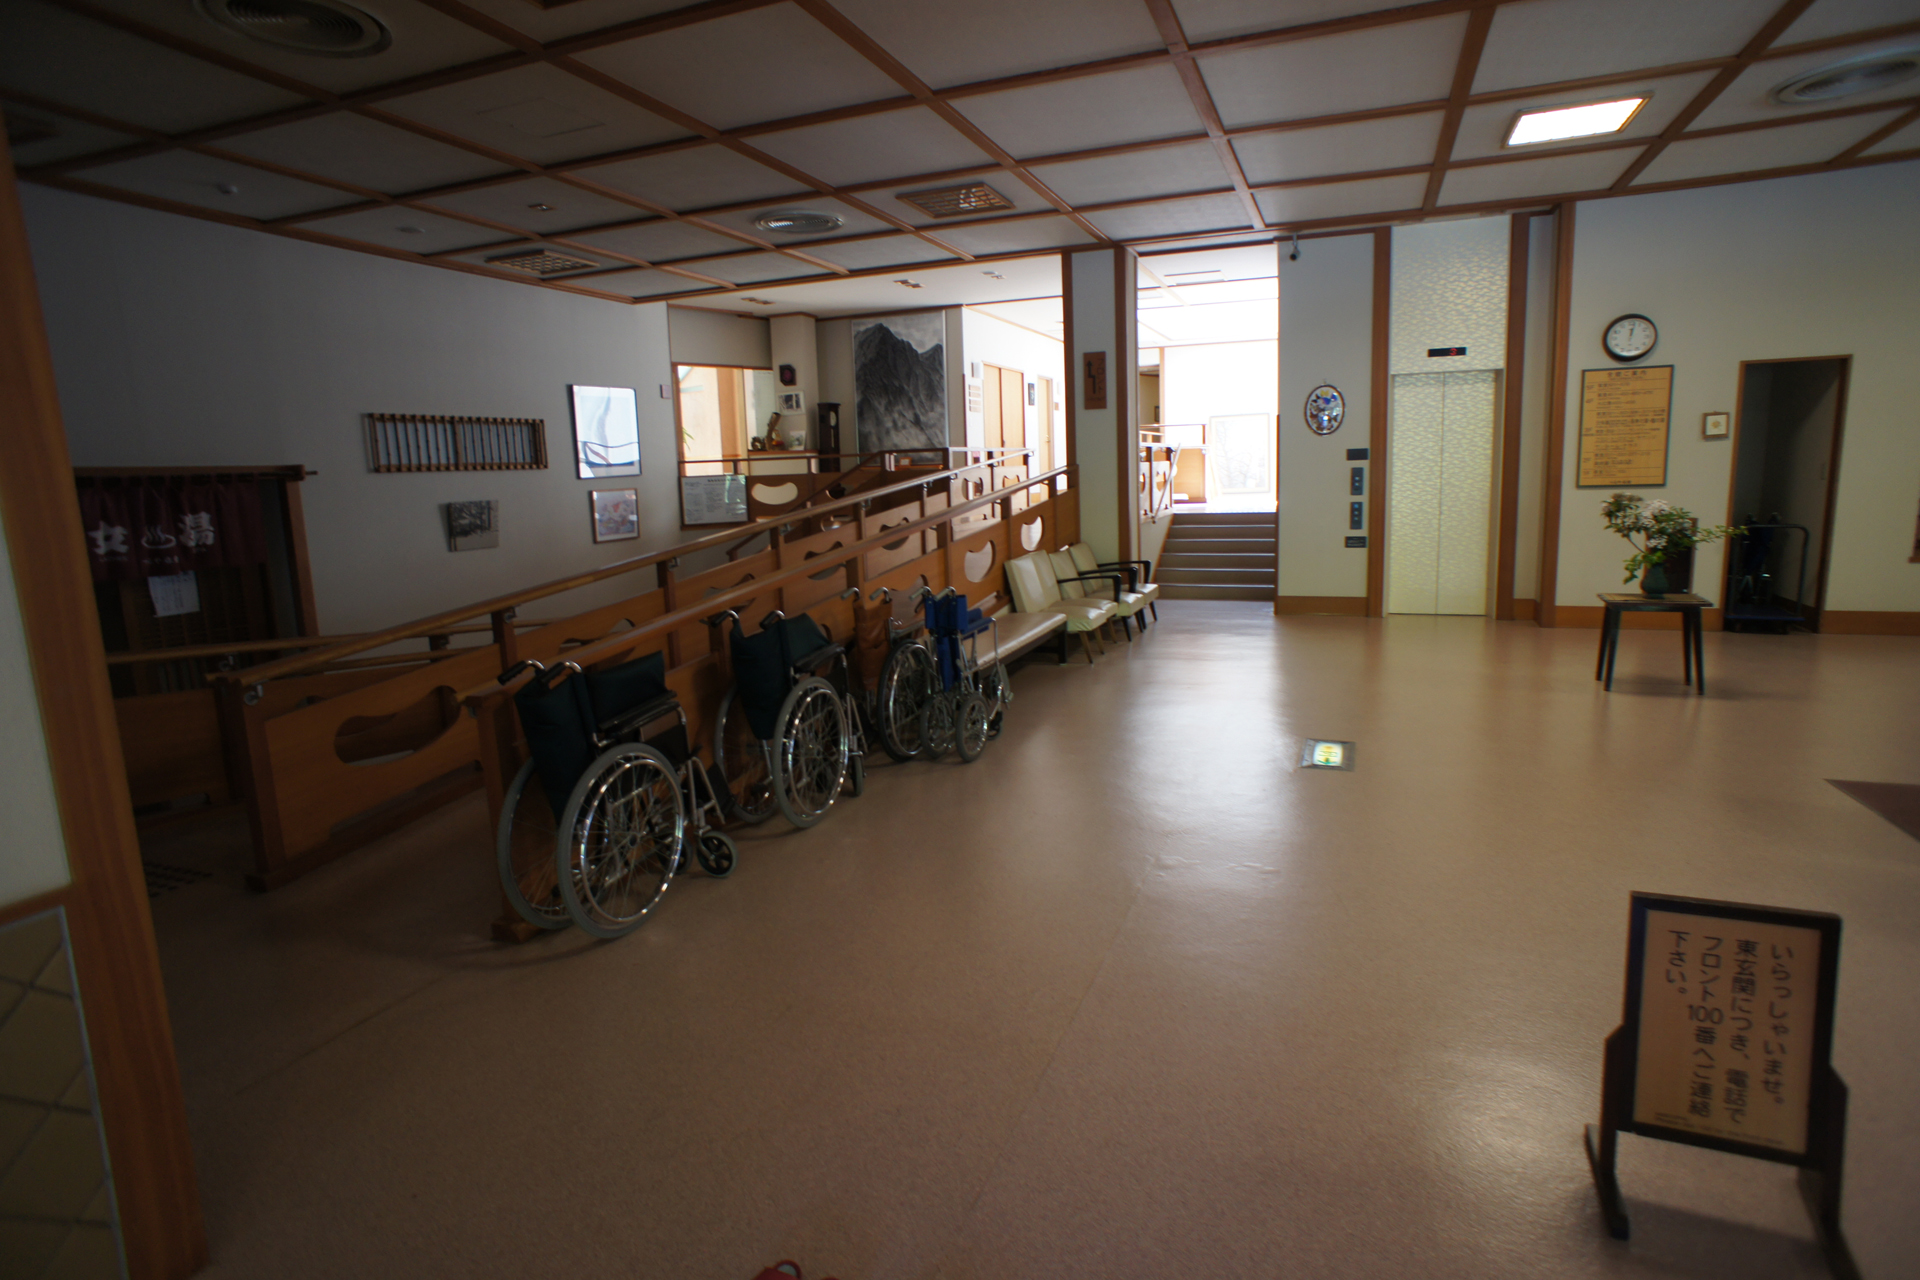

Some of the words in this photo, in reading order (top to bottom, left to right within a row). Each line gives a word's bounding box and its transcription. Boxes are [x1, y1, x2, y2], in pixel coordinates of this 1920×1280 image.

[1449, 347, 1458, 356] 3
[87, 520, 130, 556] 女
[177, 511, 216, 548] 湯
[1665, 929, 1691, 995] 下さい。
